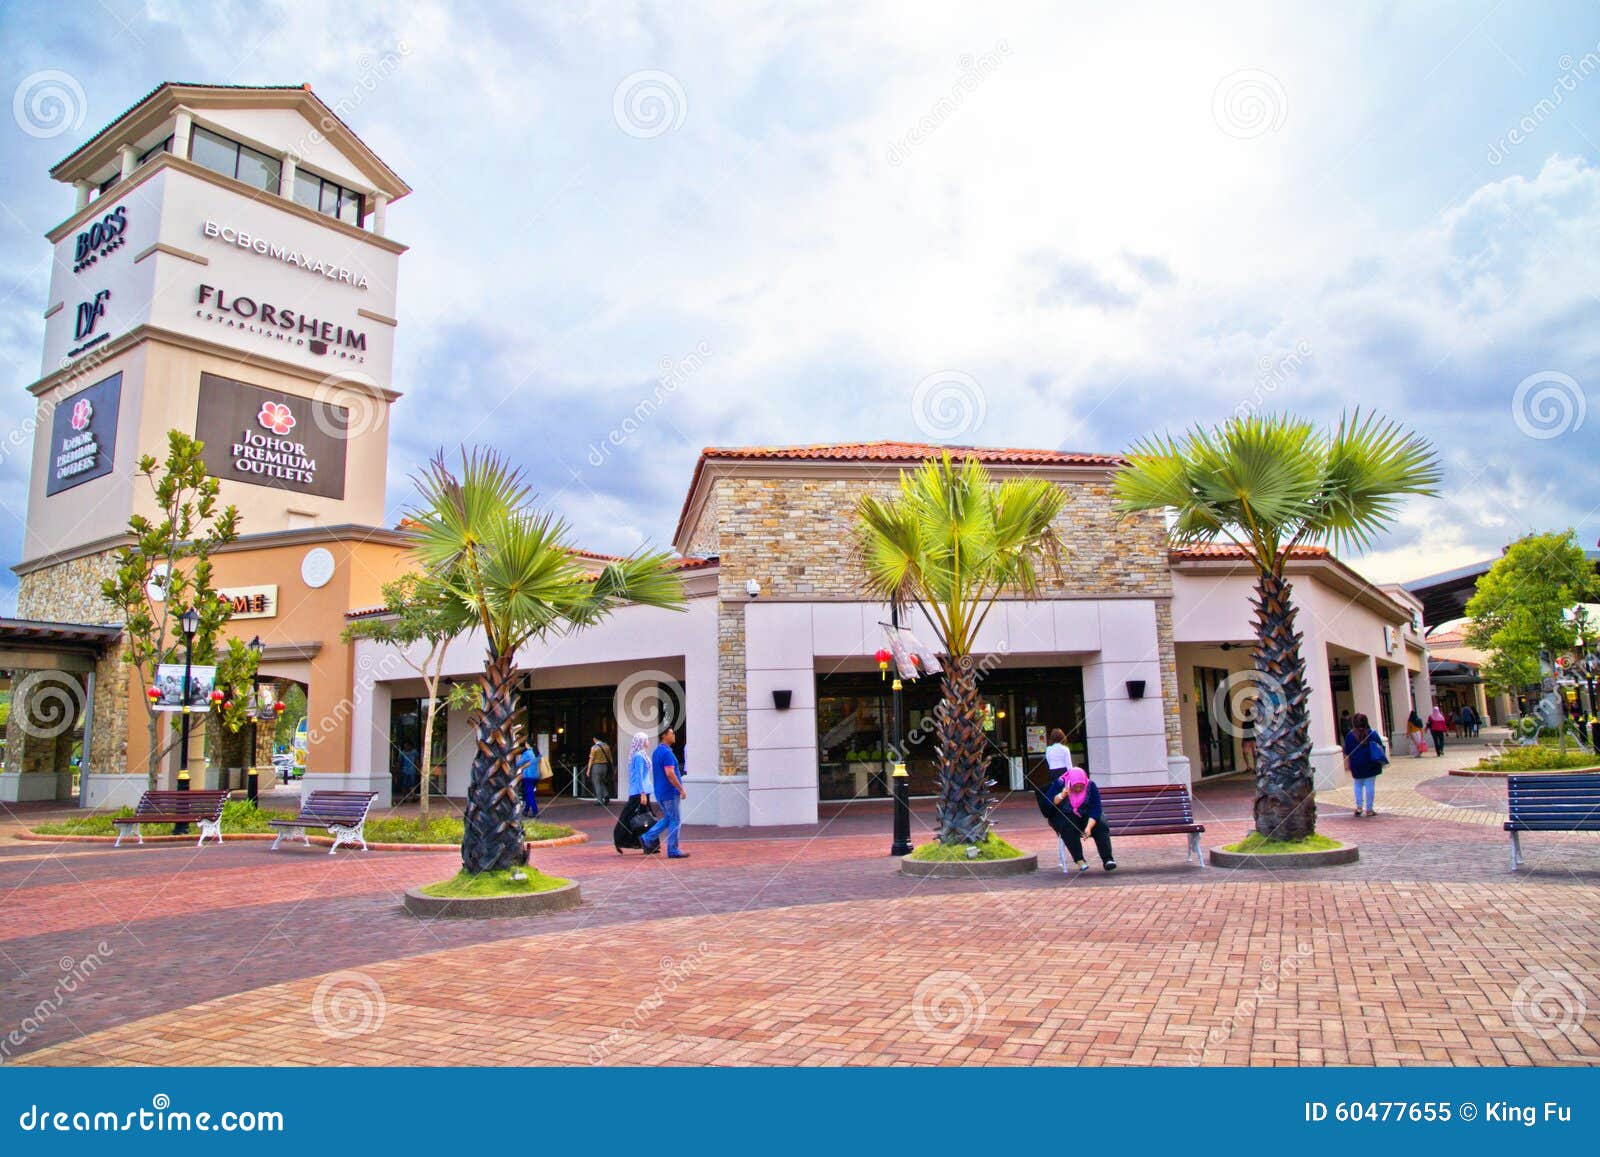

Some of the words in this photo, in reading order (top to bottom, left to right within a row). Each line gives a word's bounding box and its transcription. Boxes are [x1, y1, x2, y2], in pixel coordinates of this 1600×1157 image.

[74, 205, 127, 262] BOSS
[203, 221, 369, 289] BCBGMAXAZRIA
[197, 310, 303, 346] ESTABLISHED
[198, 284, 367, 350] FLORSHEIM
[63, 431, 93, 452] JOHOR
[233, 443, 316, 471] PREMIUM
[244, 429, 307, 456] JOHOR
[235, 458, 313, 483] OUTLETS
